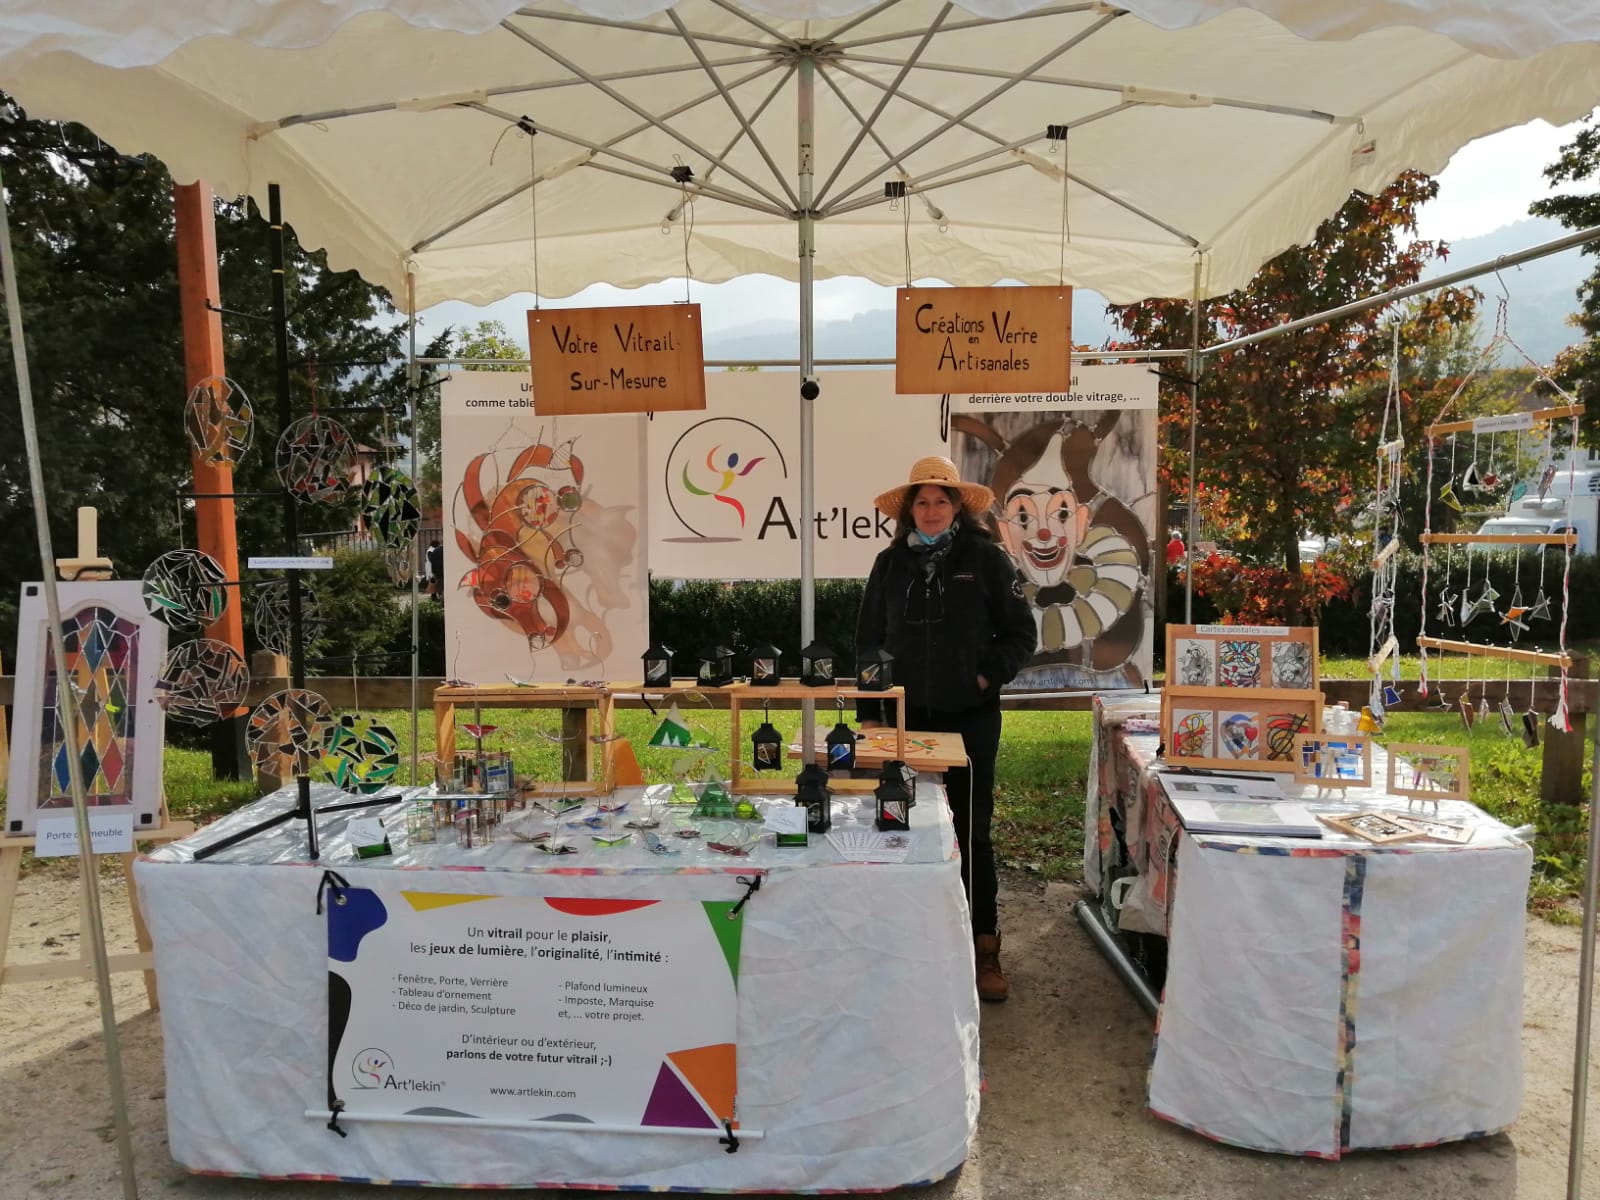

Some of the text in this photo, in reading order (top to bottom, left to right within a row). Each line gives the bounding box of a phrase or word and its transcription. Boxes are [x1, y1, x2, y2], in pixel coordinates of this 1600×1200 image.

[915, 303, 1038, 344] Créations en Verre
[551, 322, 675, 354] Votre Vitrail
[937, 335, 1030, 371] Artisanales
[570, 367, 667, 391] Sur-Mesure
[465, 397, 535, 408] comme table
[968, 393, 1012, 404] derrière
[1014, 394, 1043, 403] votre
[1045, 391, 1084, 403] double
[1085, 391, 1127, 403] vitrage,
[1200, 625, 1226, 633] Cartes
[1227, 626, 1260, 634] postales
[46, 831, 73, 840] Porte
[467, 927, 612, 944] Un vitrail pour le plaisir,
[410, 942, 427, 953] les
[429, 942, 455, 956] jeux
[458, 944, 474, 955] de
[477, 944, 528, 958] lumière,
[530, 946, 603, 962] l'originalité,
[606, 948, 662, 963] l'intimité
[398, 973, 437, 985] Fenêtre,
[439, 976, 468, 987] Porte,
[470, 977, 509, 988] Verrière
[564, 981, 601, 992] Plafond
[603, 983, 648, 993] lumineux
[398, 987, 435, 998] Tableau
[436, 989, 492, 1000] d'ornement
[398, 1001, 422, 1011] Déco
[424, 1002, 437, 1012] de
[438, 1003, 469, 1015] jardin,
[471, 1004, 517, 1017] Sculpture
[564, 996, 607, 1007] Imposte,
[609, 997, 655, 1008] Marquise
[585, 1011, 610, 1020] votre
[612, 1012, 645, 1022] projet.
[462, 1034, 597, 1051] D'intérieur ou d'extérieur,
[446, 1050, 487, 1060] parlons
[489, 1051, 503, 1061] de
[505, 1052, 534, 1062] votre
[536, 1052, 564, 1063] futur
[566, 1053, 598, 1065] vitrail
[490, 1087, 577, 1099] www.artlekin.com
